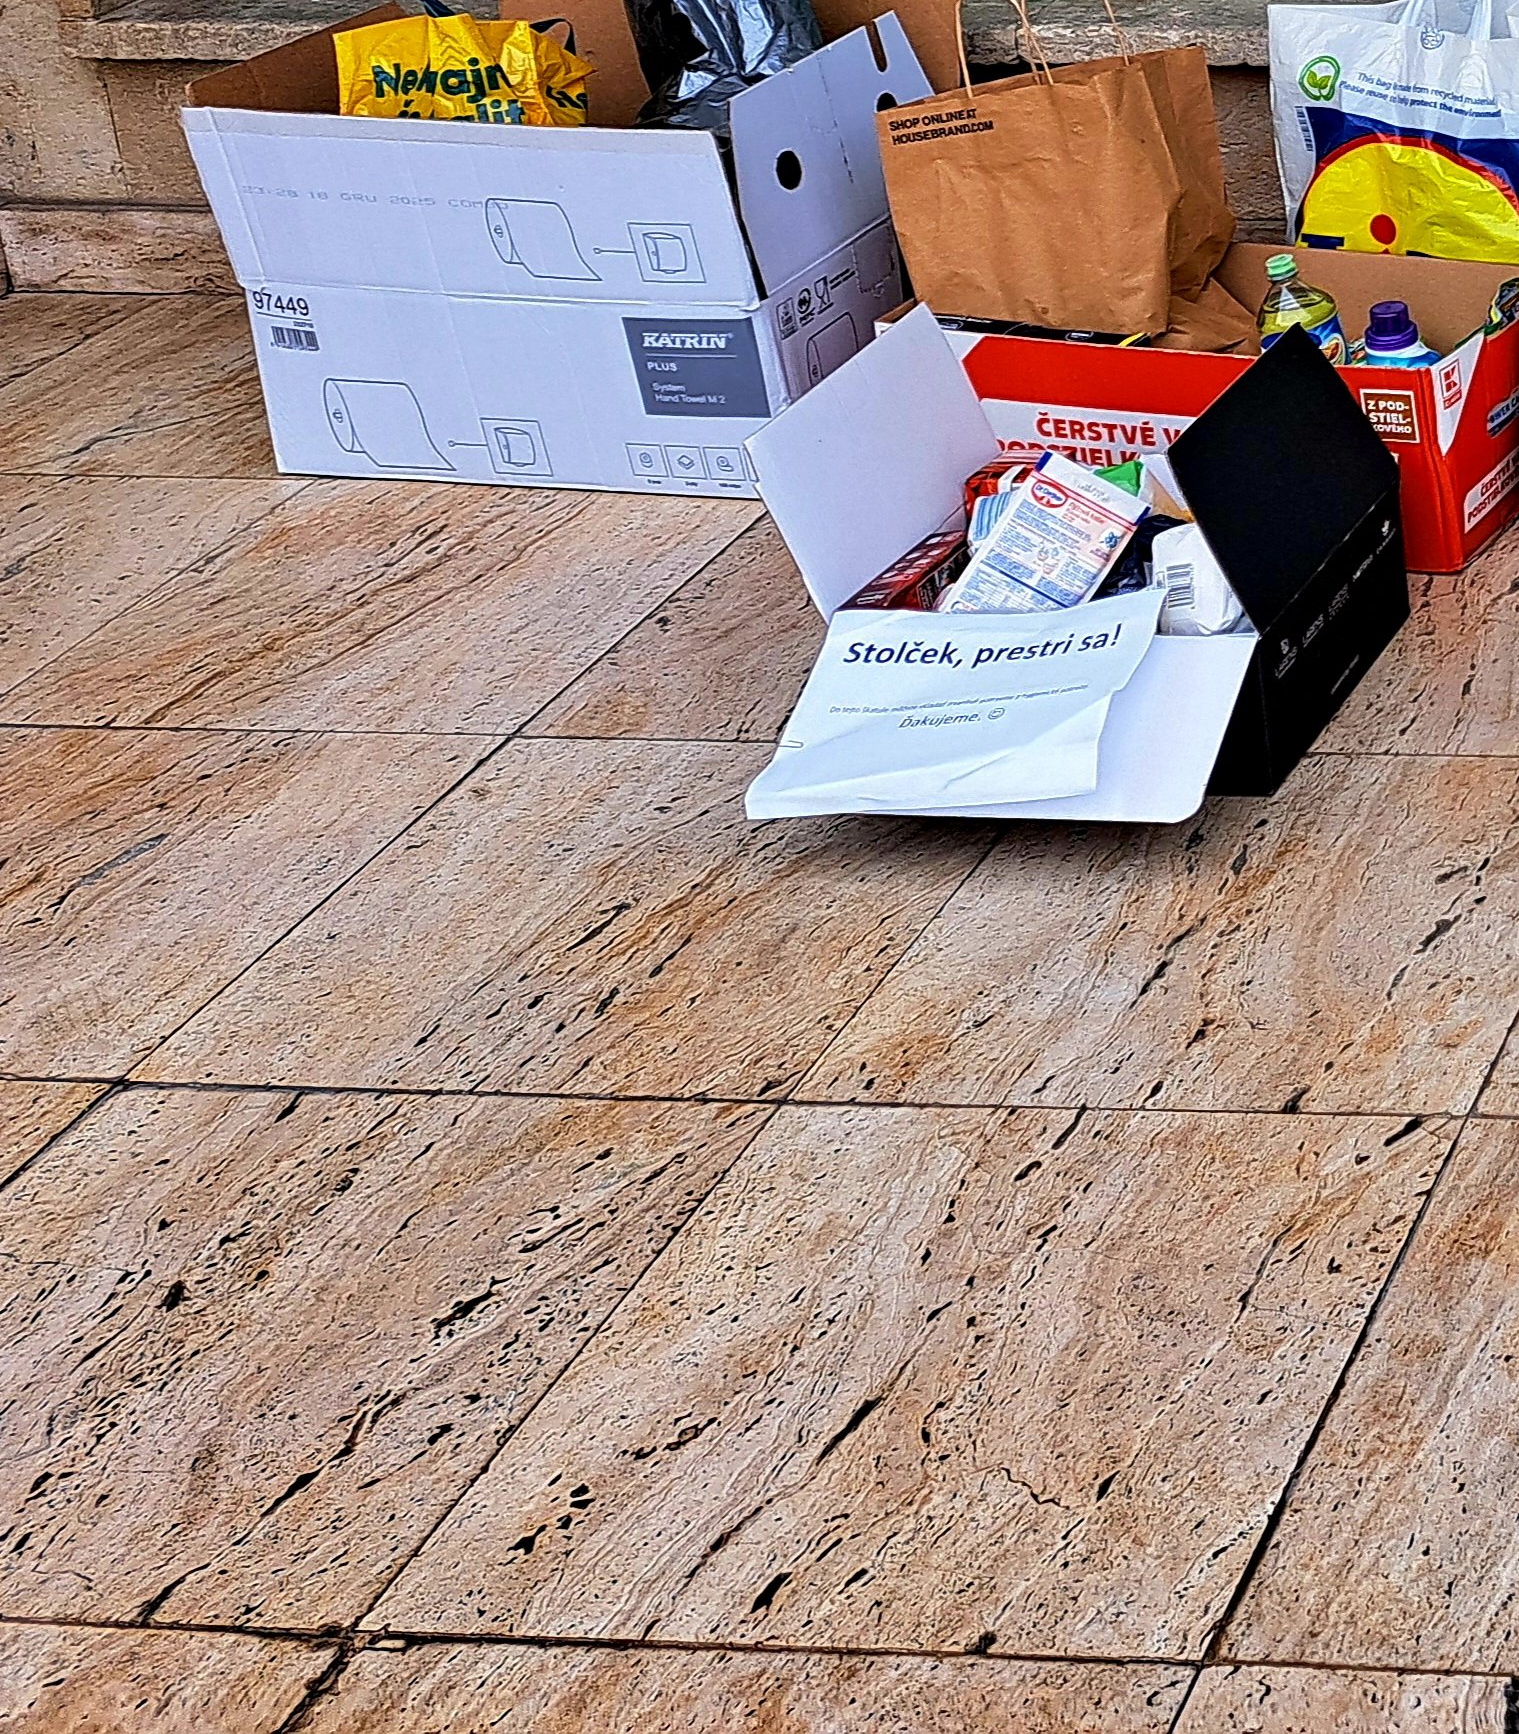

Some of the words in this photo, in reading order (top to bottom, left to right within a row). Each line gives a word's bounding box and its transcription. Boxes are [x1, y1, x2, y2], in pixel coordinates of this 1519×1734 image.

[1339, 80, 1365, 94] Please
[1366, 89, 1388, 100] reuse
[1410, 97, 1437, 108] protect
[1439, 102, 1452, 112] the
[1358, 71, 1374, 85] This
[1376, 77, 1391, 91] bag
[1430, 88, 1463, 103] recycled
[889, 118, 920, 131] SHOP
[922, 110, 966, 126] ONLINE
[965, 108, 977, 119] AT
[892, 120, 994, 145] HOUSEBRAND.COM
[389, 195, 437, 206] 2025
[252, 289, 309, 316] 97449
[647, 361, 677, 372] PLUS
[1368, 400, 1377, 410] Z
[1379, 400, 1410, 412] POD-
[1036, 411, 1157, 447] ČERSTVÉ
[1370, 413, 1411, 424] STIEL-
[843, 641, 964, 669] Stolček,
[971, 633, 1075, 669] prestri
[1077, 623, 1122, 652] sa!
[829, 706, 839, 714] Do
[899, 712, 982, 728] Ďakujeme.
